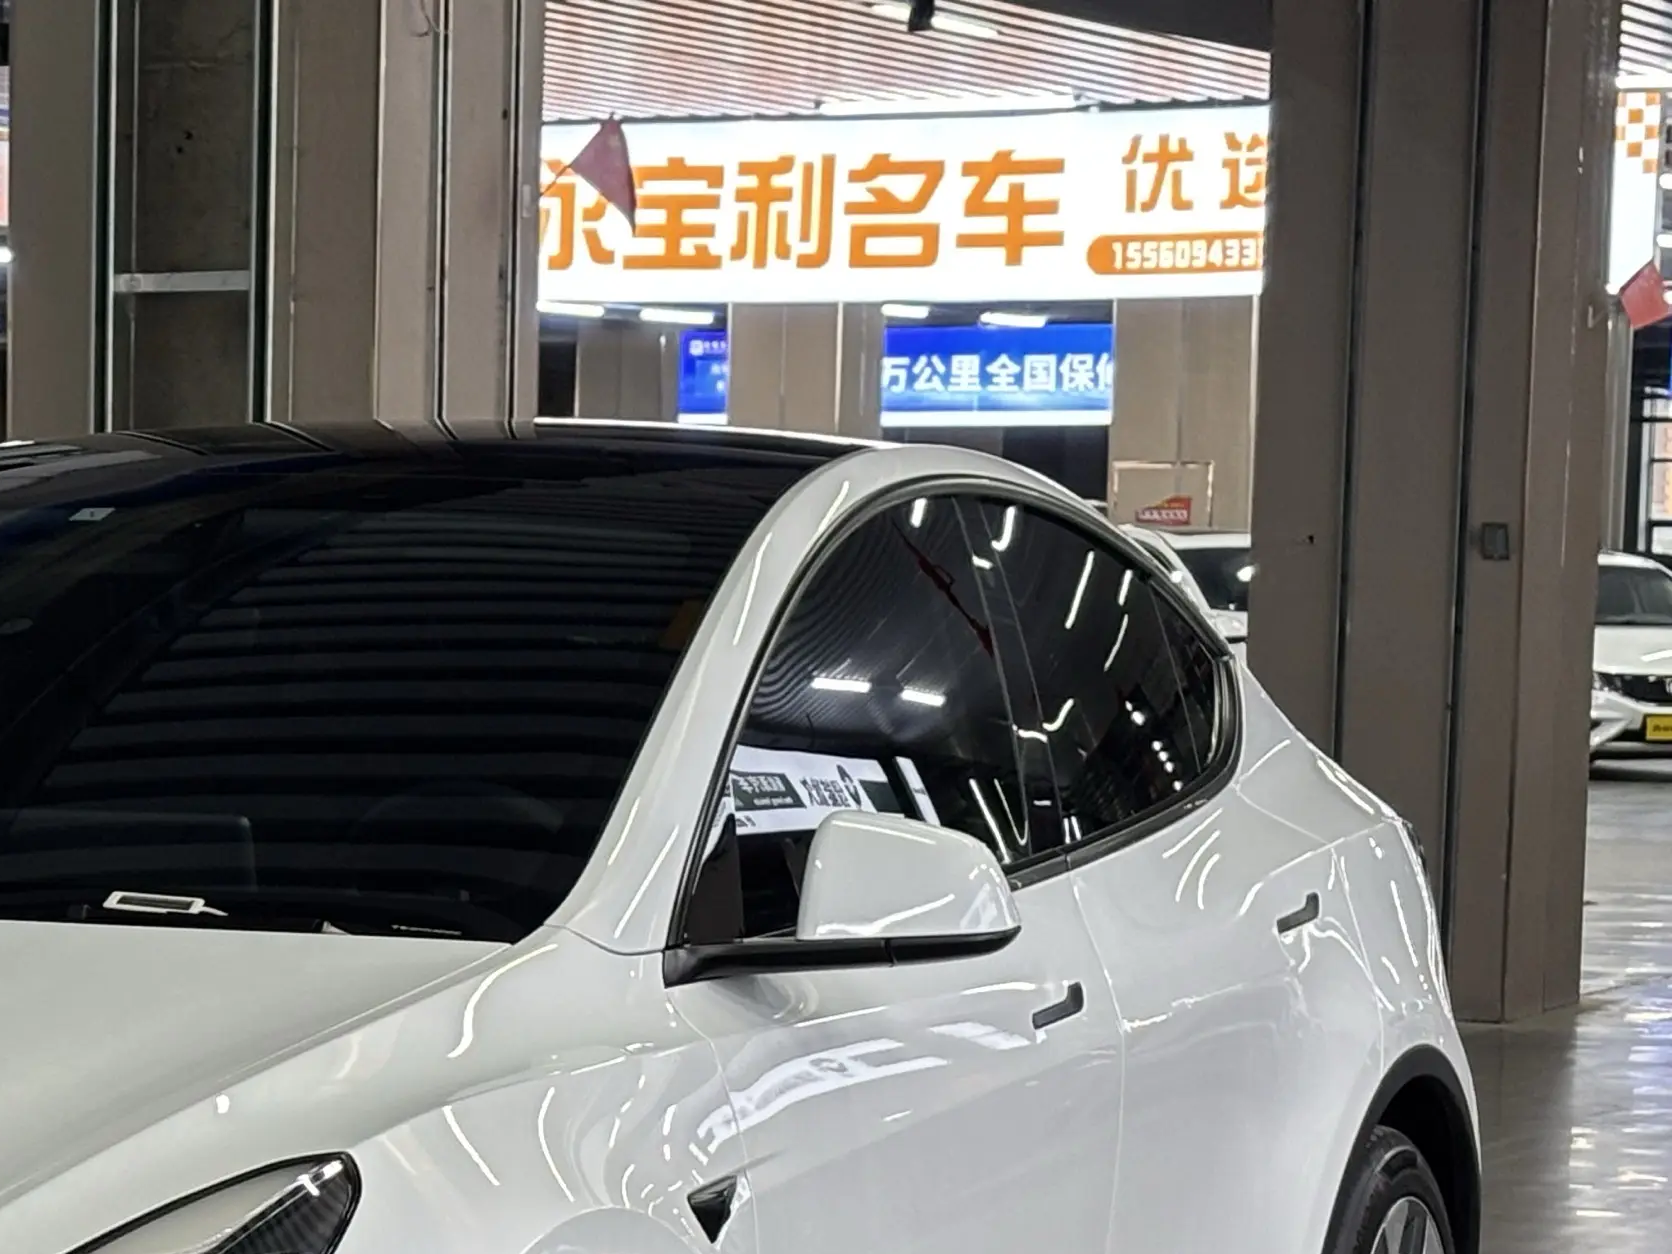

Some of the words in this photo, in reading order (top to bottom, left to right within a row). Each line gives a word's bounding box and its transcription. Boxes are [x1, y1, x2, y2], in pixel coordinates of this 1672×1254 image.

[540, 148, 1066, 271] 永宝利名车
[1122, 132, 1266, 212] 优选
[1112, 237, 1264, 270] 155609433
